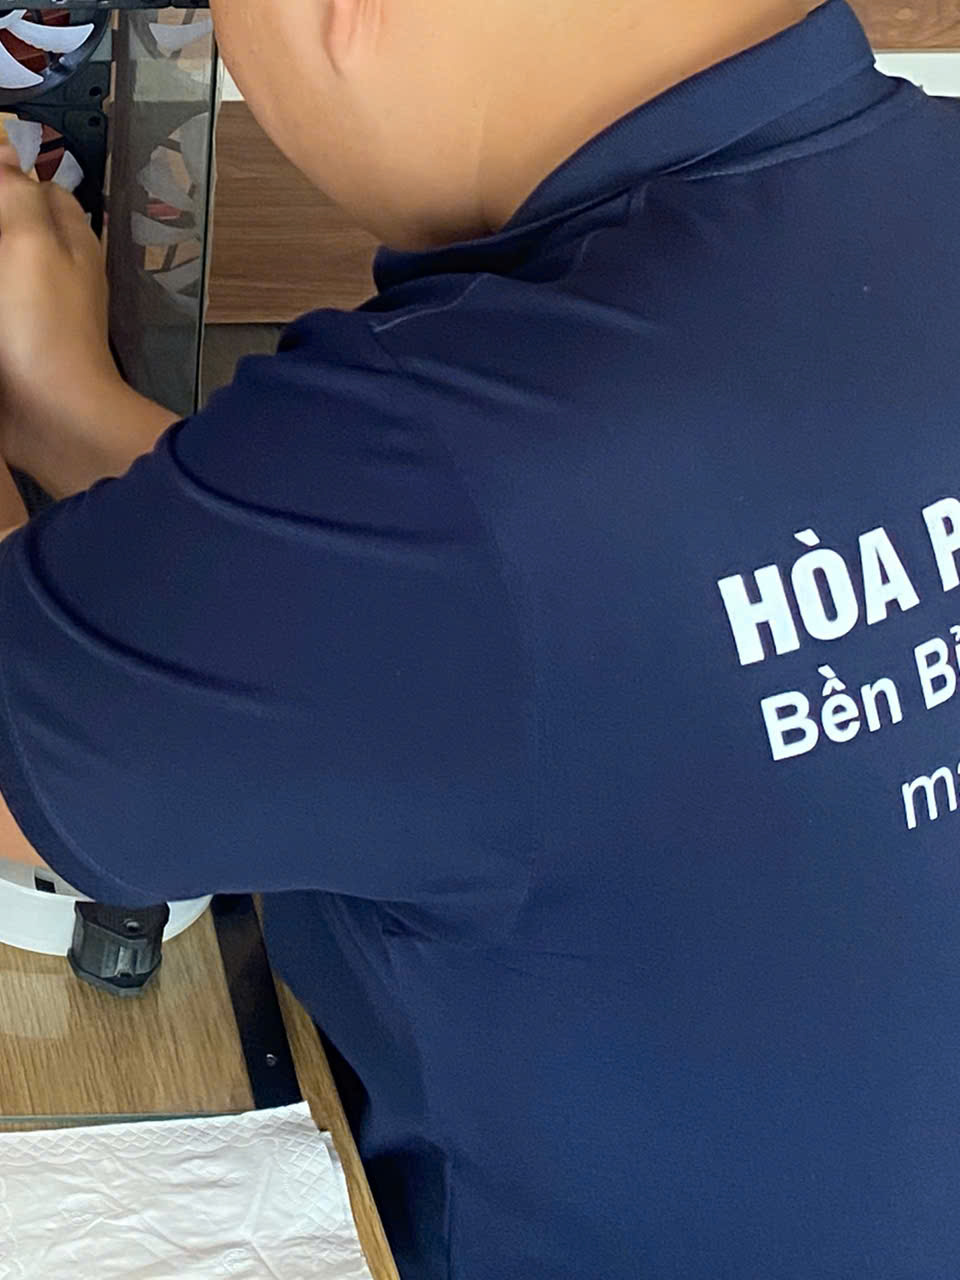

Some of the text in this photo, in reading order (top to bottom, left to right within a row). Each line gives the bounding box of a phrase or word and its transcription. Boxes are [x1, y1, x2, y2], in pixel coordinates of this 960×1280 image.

[717, 528, 920, 666] HÒA
[760, 664, 903, 761] Bền
[901, 762, 960, 830] m
